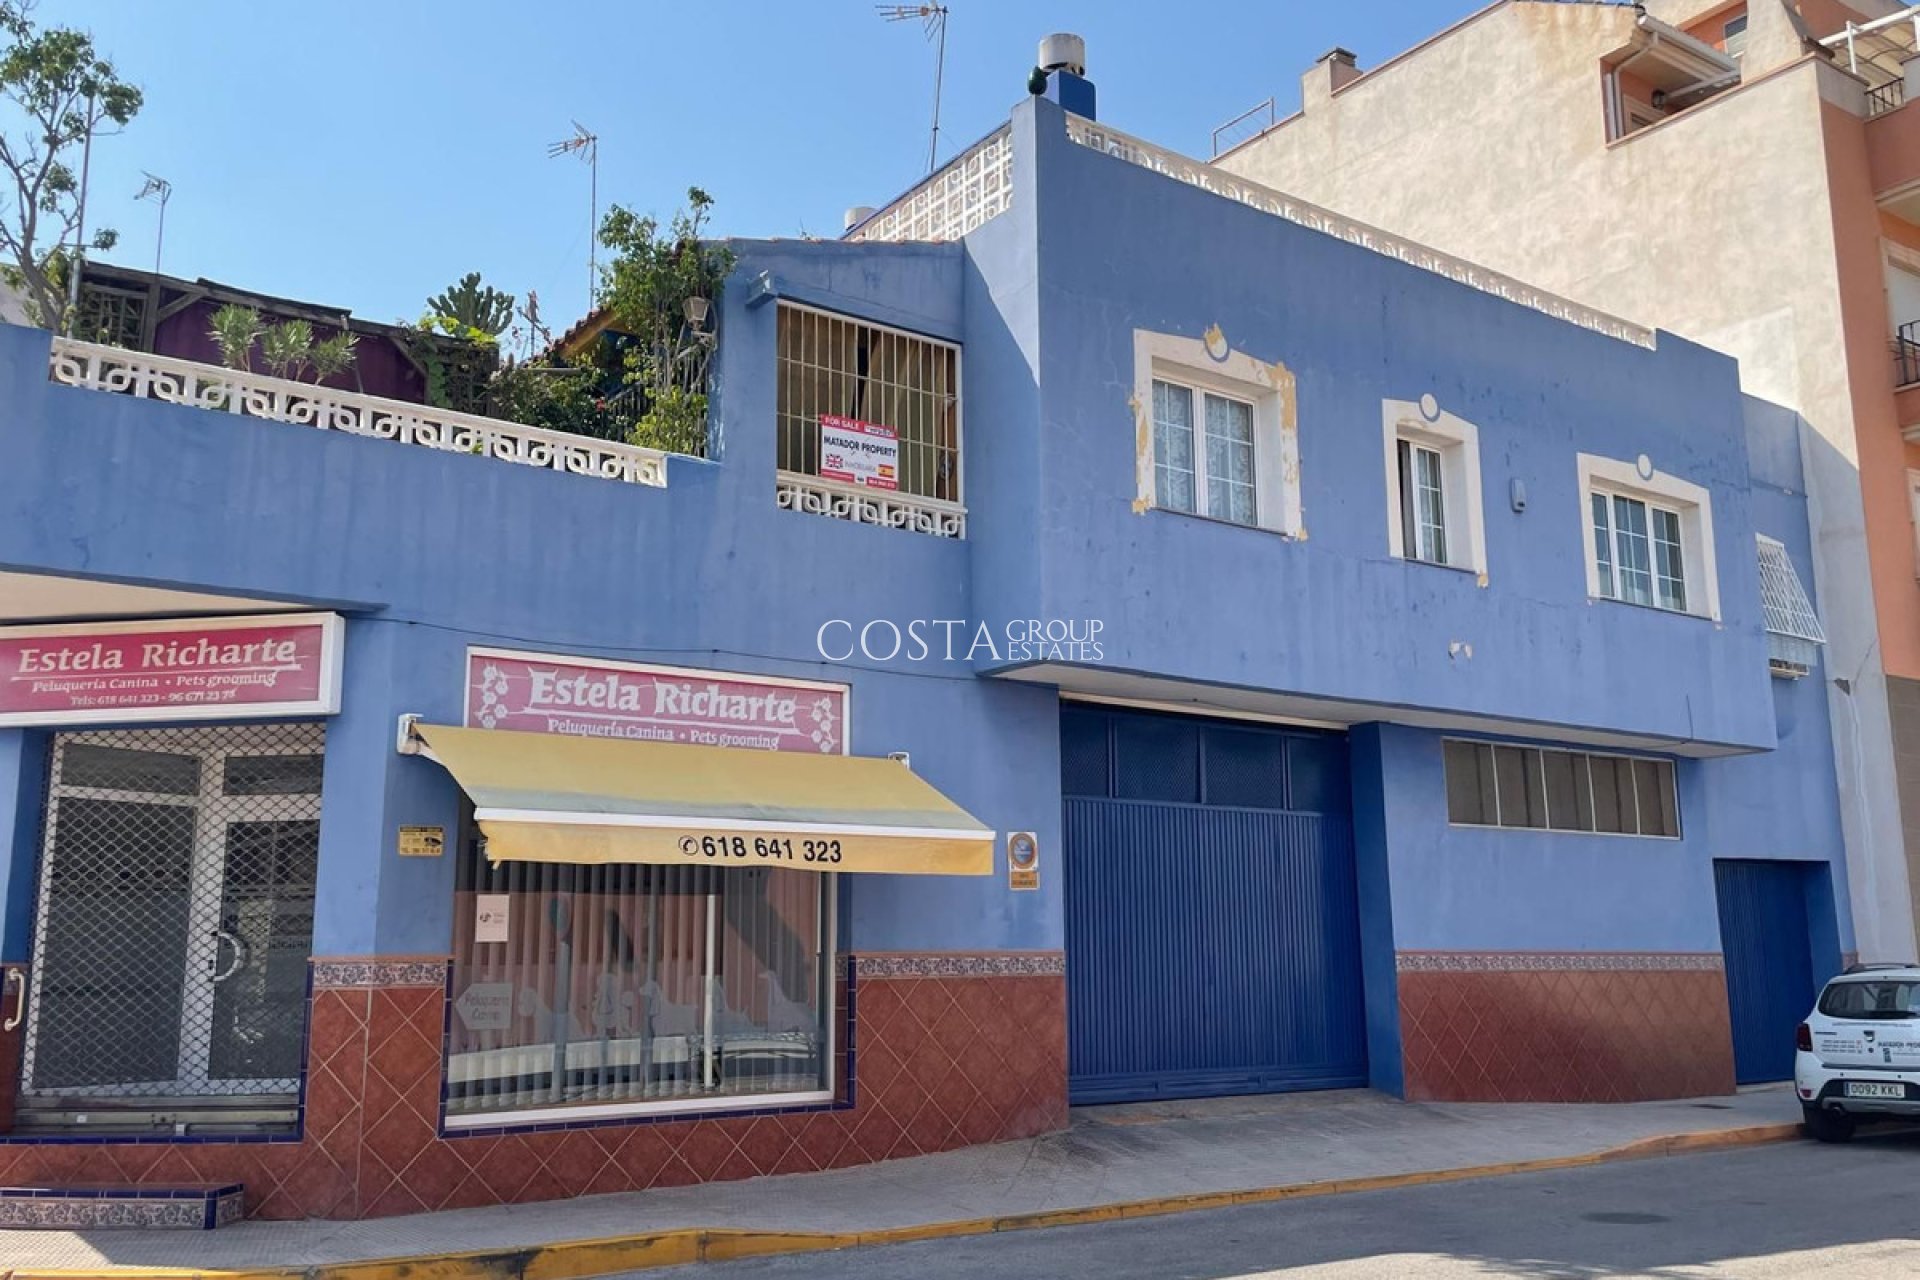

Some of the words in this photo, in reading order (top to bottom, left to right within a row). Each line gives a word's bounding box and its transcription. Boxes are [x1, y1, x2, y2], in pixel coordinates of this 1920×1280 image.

[825, 416, 840, 427] FOR
[842, 419, 859, 430] SALE
[824, 435, 860, 451] MATADOR
[862, 442, 896, 457] PROPERTY
[18, 643, 124, 673] Estela
[141, 637, 298, 668] Richarte
[109, 677, 159, 690] Canina
[176, 675, 206, 687] Pets
[207, 669, 279, 688] grooming
[529, 667, 642, 711] Estela
[654, 680, 797, 723] Richarte
[625, 724, 675, 741] Canina
[690, 729, 718, 745] Pets
[718, 733, 780, 751] grooming
[701, 836, 747, 857] 618
[753, 837, 795, 860] 641
[802, 839, 843, 863] 323
[1851, 1085, 1878, 1095] 0092
[1881, 1085, 1902, 1096] KKL
